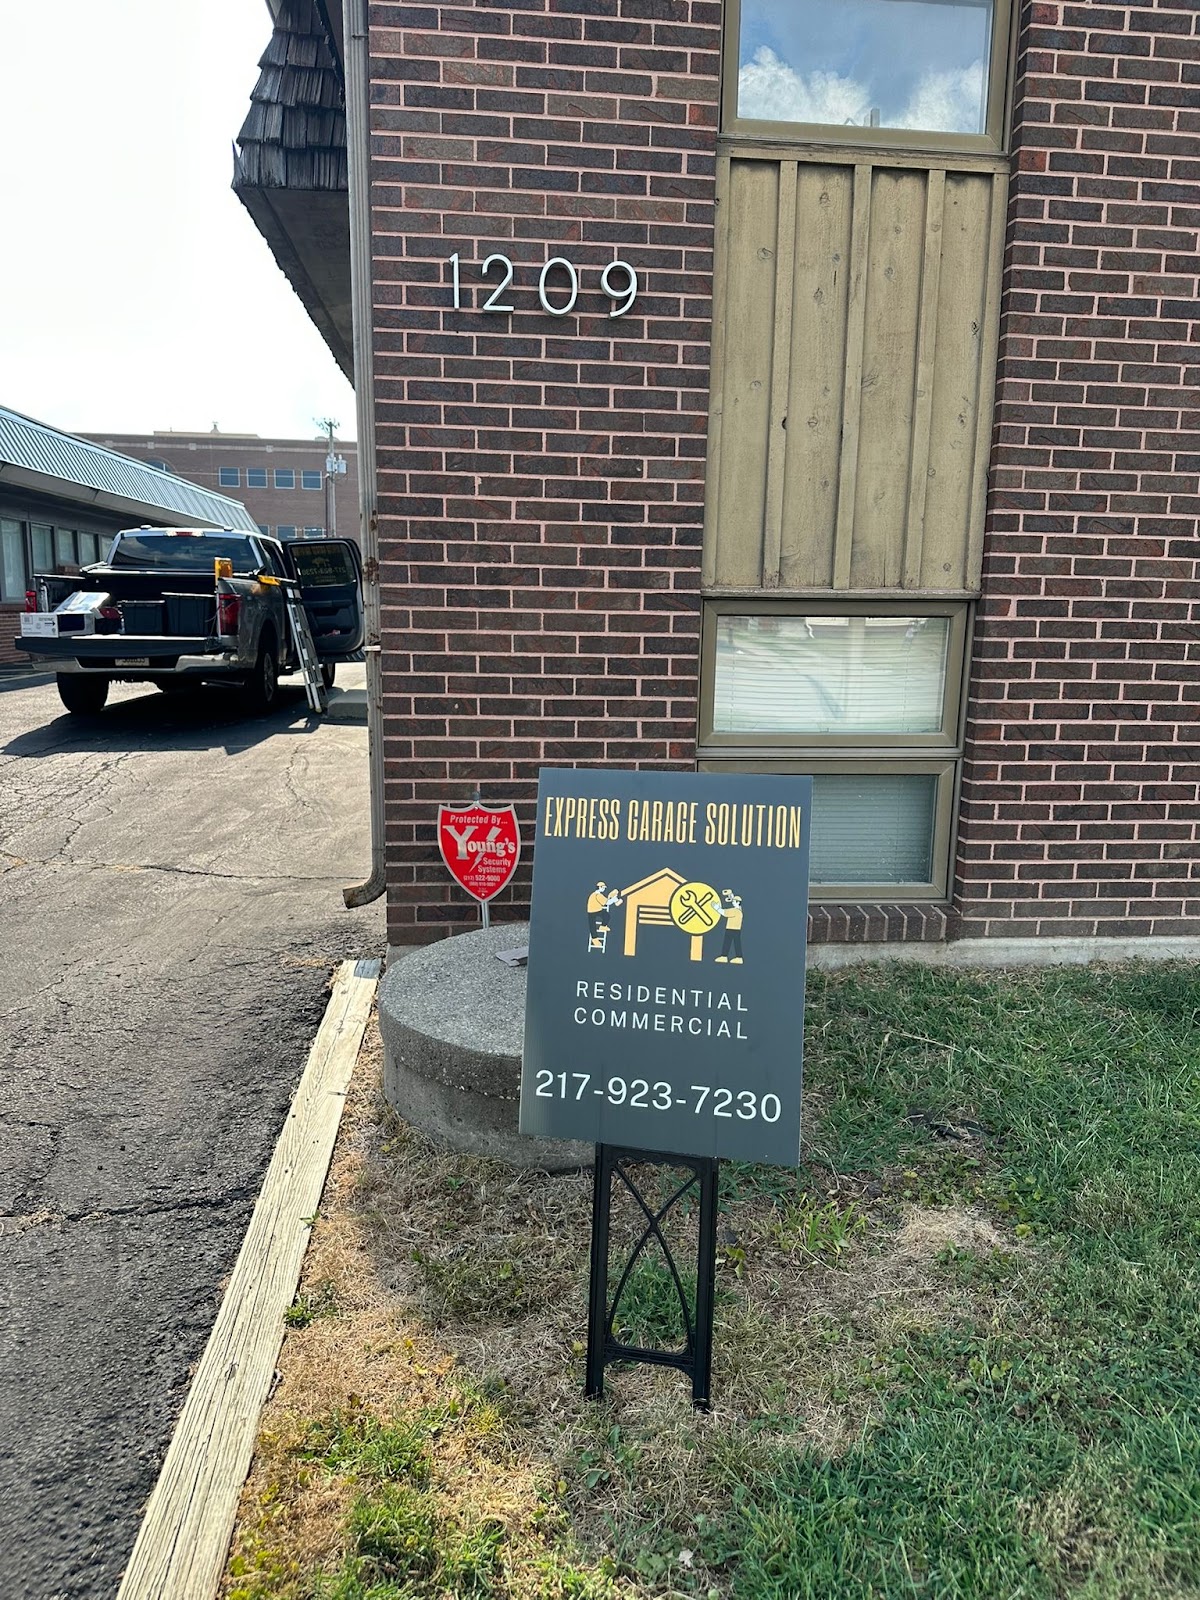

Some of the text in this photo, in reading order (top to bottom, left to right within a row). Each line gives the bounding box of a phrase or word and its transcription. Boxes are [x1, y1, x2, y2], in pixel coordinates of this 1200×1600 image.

[449, 252, 638, 319] 1209
[450, 814, 489, 824] Protected
[544, 796, 802, 849] EXPRESS GARAGE SOLUTION
[442, 825, 516, 860] Young's
[477, 865, 507, 874] Systems
[483, 857, 512, 868] Security
[576, 980, 748, 1012] RESIDENTIAL
[573, 1006, 748, 1040] COMMERCIAL
[535, 1069, 782, 1123] 217-923-7230
